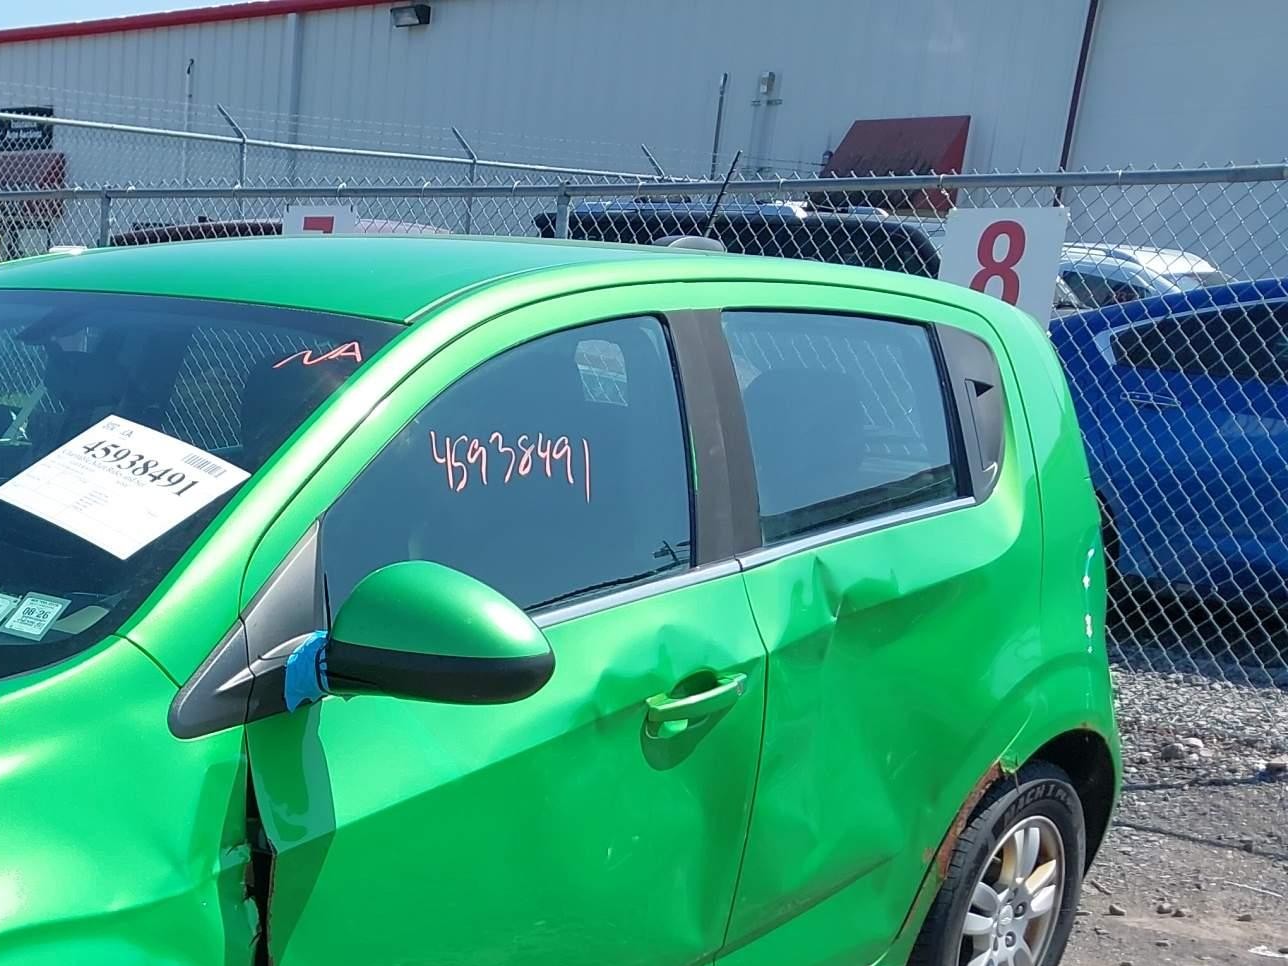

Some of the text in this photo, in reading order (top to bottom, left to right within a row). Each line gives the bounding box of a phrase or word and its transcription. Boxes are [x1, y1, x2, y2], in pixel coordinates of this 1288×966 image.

[969, 219, 1027, 307] 8
[81, 439, 200, 497] 45938491
[429, 430, 590, 505] 45938491
